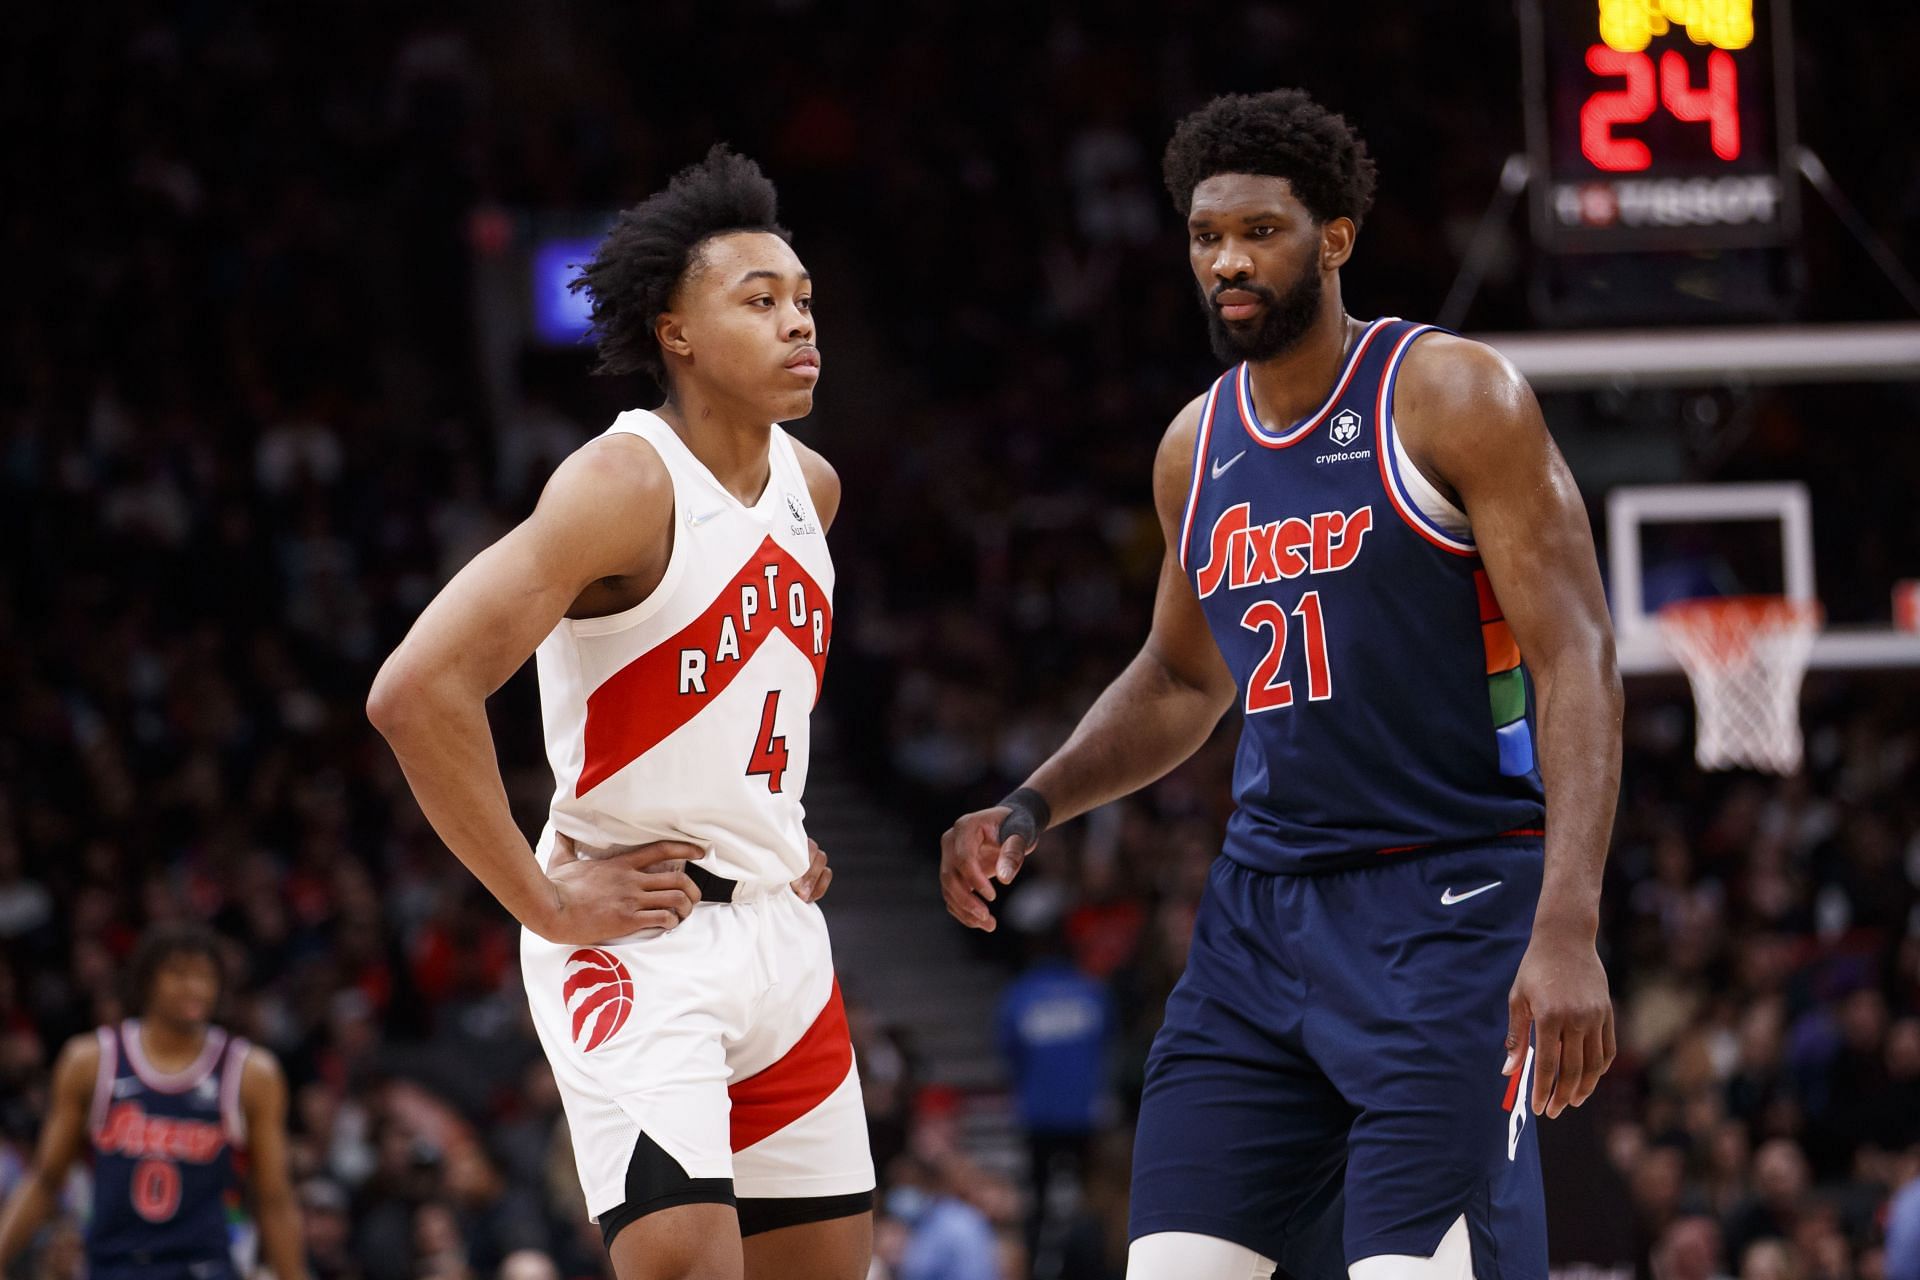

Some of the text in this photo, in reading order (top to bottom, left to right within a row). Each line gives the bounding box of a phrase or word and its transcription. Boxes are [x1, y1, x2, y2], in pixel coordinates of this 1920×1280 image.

[1580, 44, 1740, 171] 24
[1316, 450, 1371, 464] crypto.com
[1197, 502, 1372, 599] Sixers
[679, 564, 830, 694] RAPTOR
[1241, 591, 1331, 714] 21
[745, 690, 789, 793] 4
[131, 1158, 182, 1223] 0
